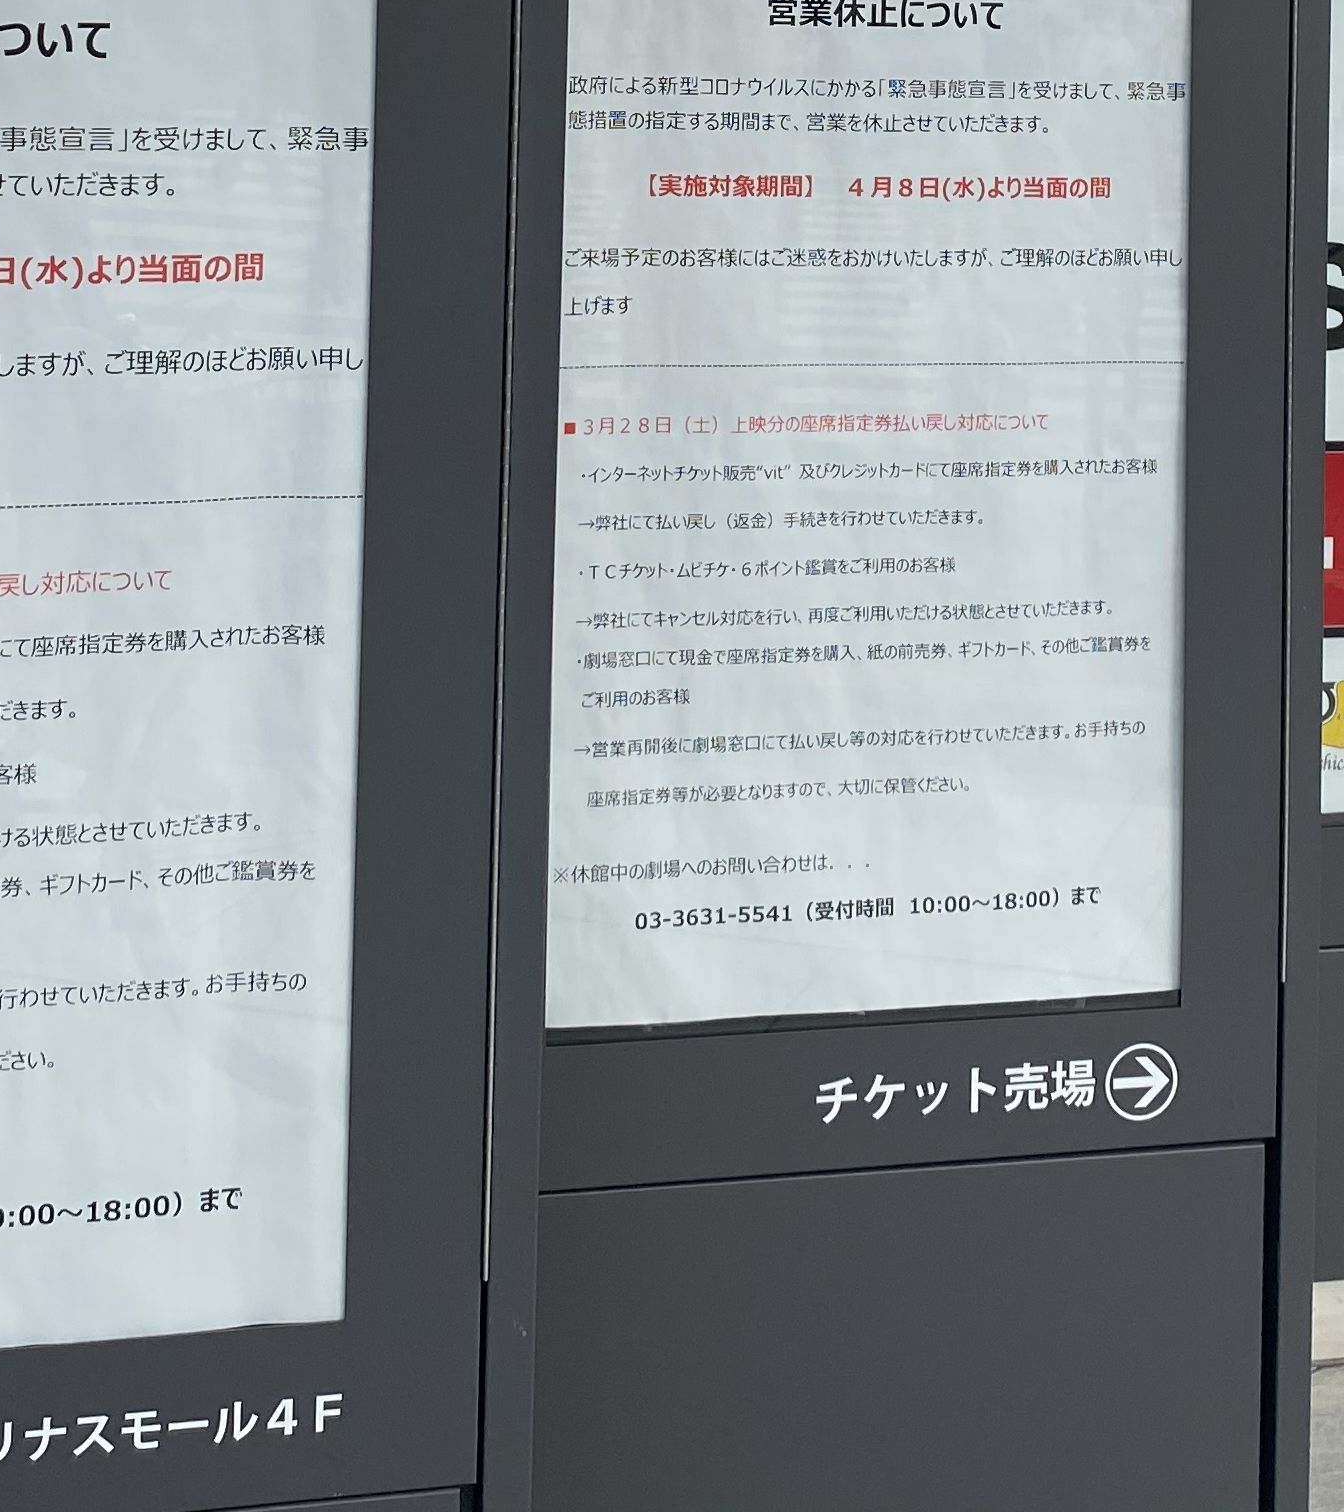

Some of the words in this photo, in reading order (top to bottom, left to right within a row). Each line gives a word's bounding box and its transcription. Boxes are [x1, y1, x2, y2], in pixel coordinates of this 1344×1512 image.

[646, 174, 814, 199] 【実施対象期間】
[563, 296, 633, 318] 上げます
[581, 688, 691, 709] ご利用のお客様
[815, 1059, 1097, 1126] チケット売場
